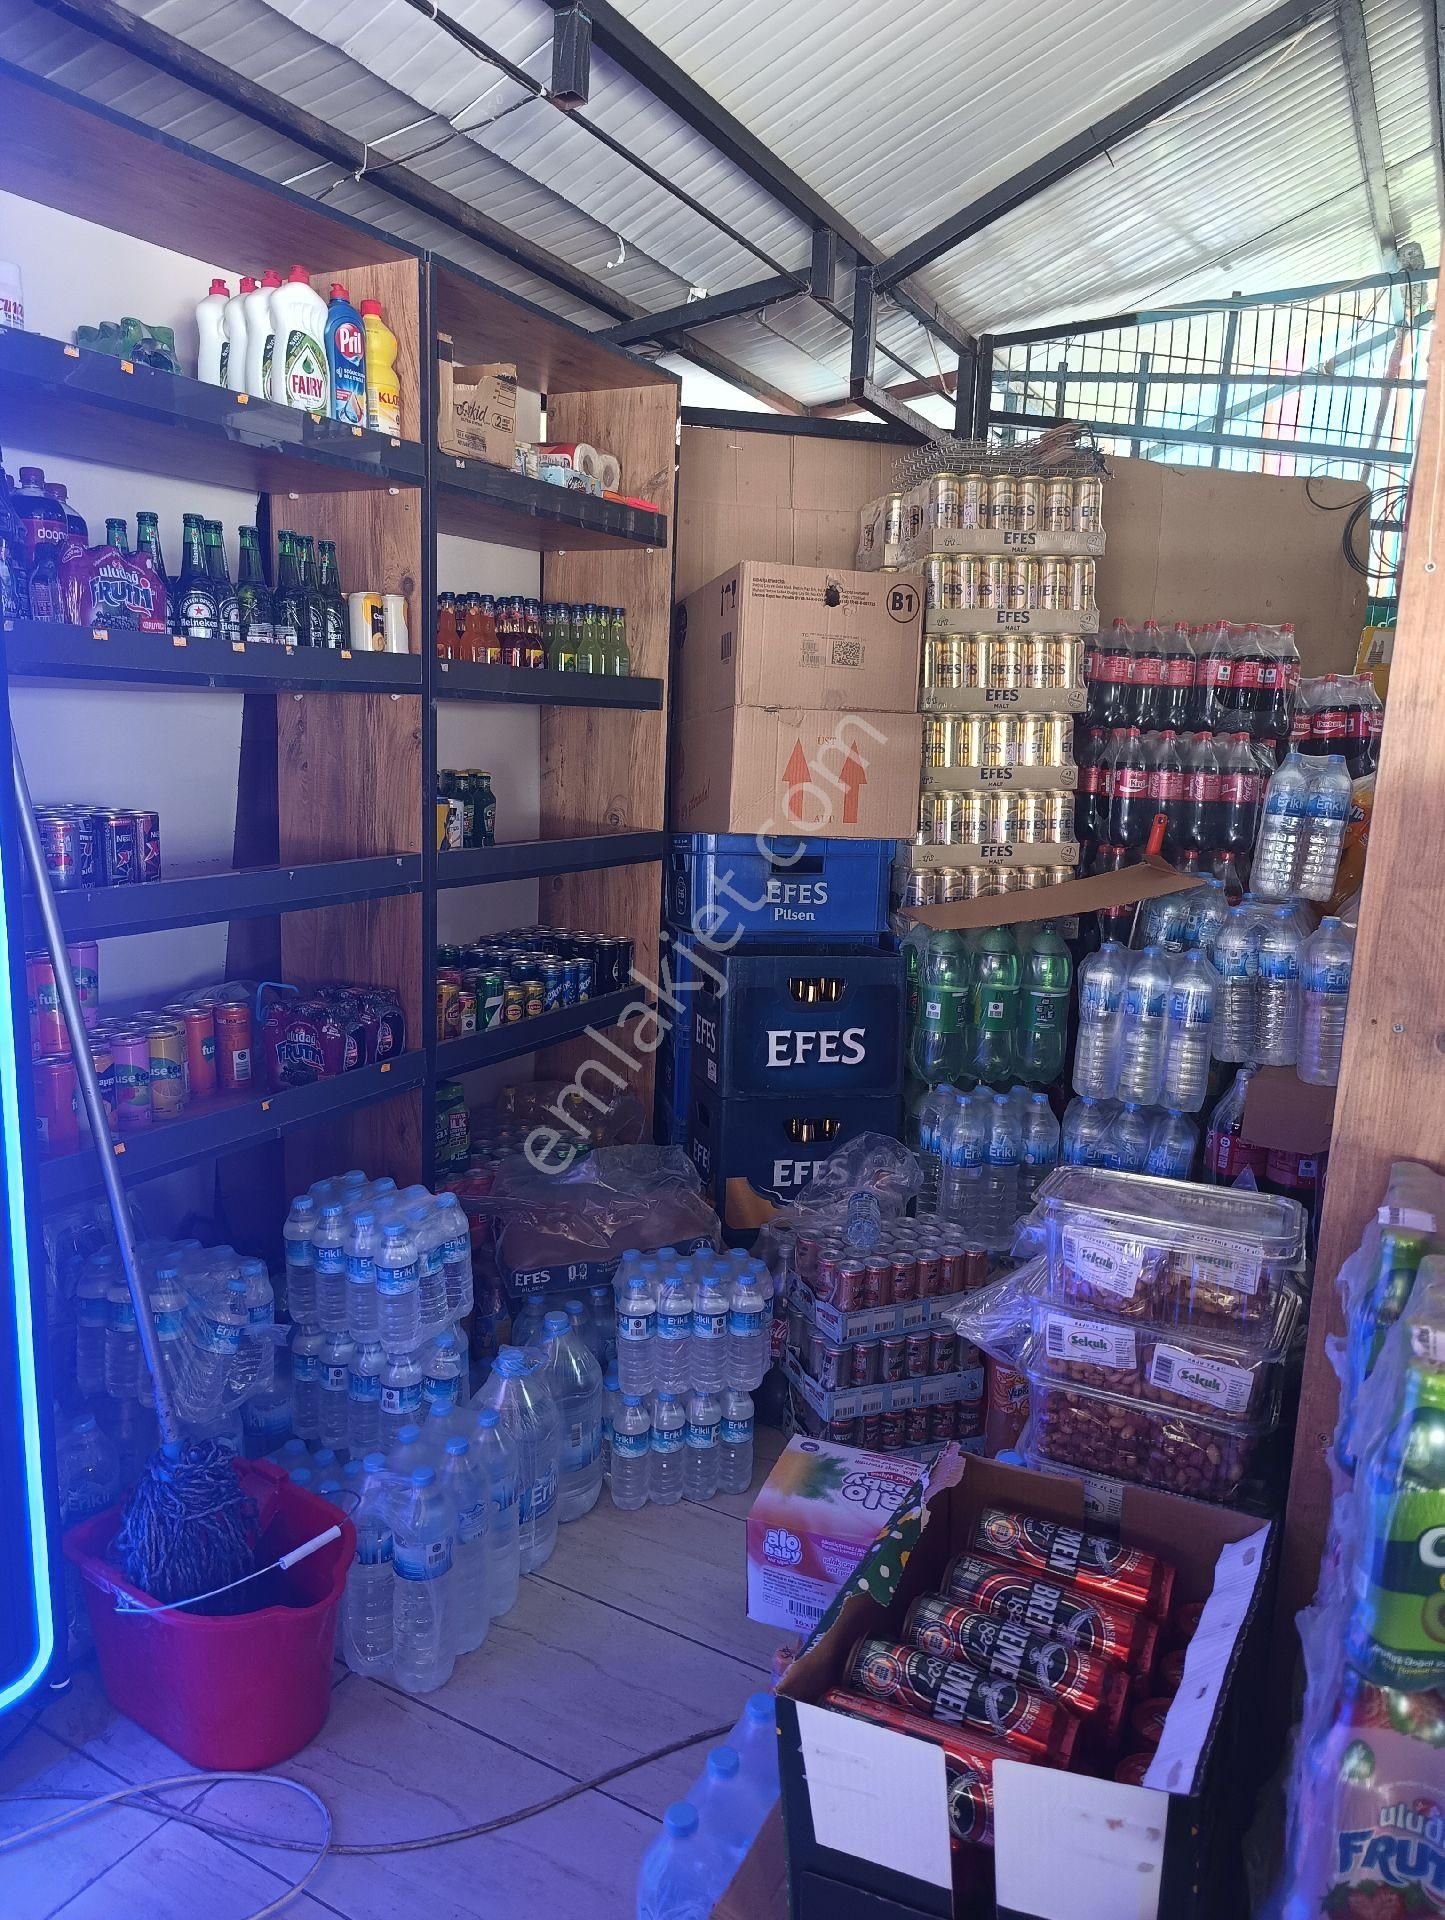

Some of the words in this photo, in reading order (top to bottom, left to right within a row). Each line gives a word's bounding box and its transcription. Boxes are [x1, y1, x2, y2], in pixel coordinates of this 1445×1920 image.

[339, 328, 362, 354] Pril
[292, 374, 324, 398] FAIRY
[1003, 532, 1037, 545] EFES
[99, 563, 140, 585] uludağ
[891, 591, 914, 613] B1
[181, 618, 218, 628] Heineken
[996, 610, 1030, 624] EFES
[985, 688, 1019, 702] EFES
[980, 767, 1013, 779] EFES
[980, 845, 1013, 858] EFES
[766, 881, 829, 905] EFES
[773, 907, 816, 922] Pilsen
[695, 1013, 717, 1054] EFES
[765, 1027, 867, 1068] EFES
[772, 1158, 850, 1188] EFES
[514, 1270, 551, 1286] EFES
[690, 1425, 710, 1435] Erikli
[728, 1421, 748, 1430] Erikli
[615, 1433, 634, 1444] Erikli
[767, 1529, 801, 1552] alo
[764, 1542, 802, 1564] baby
[973, 1620, 1003, 1656] 1827
